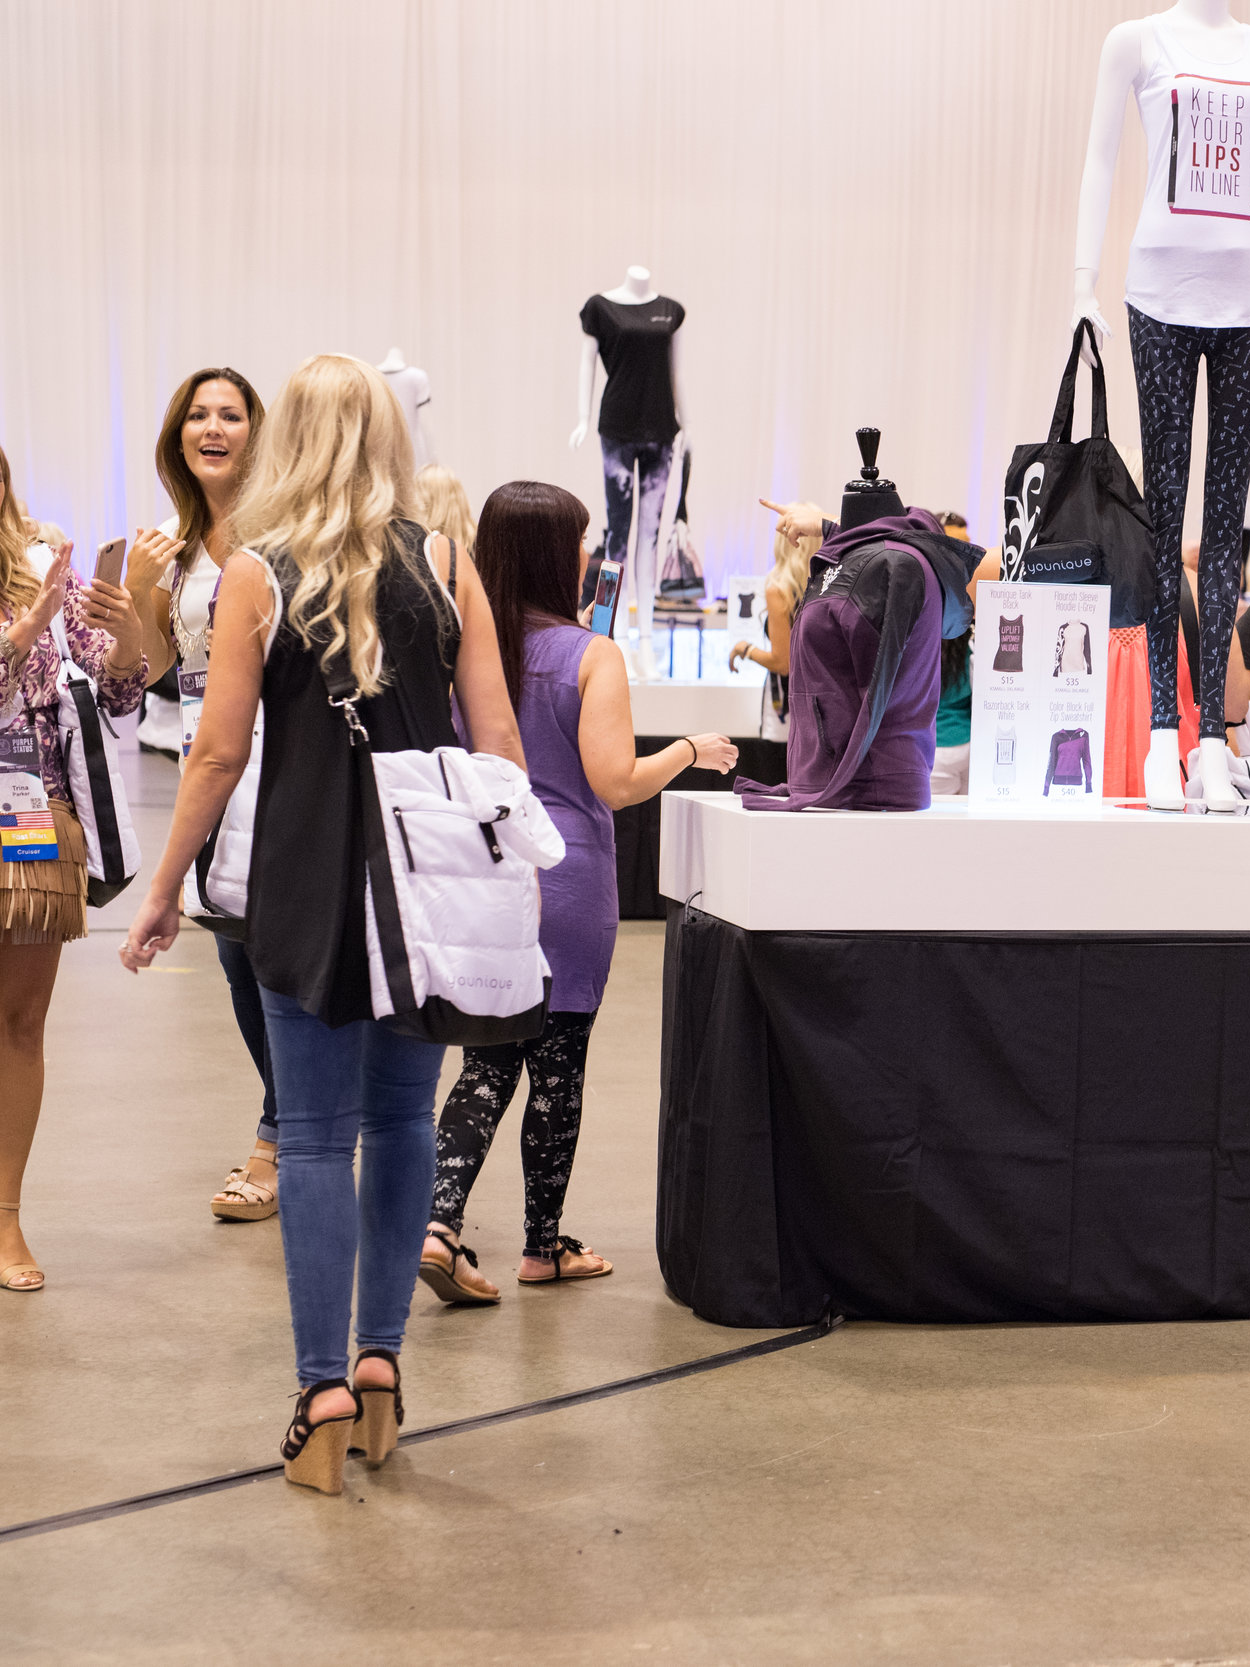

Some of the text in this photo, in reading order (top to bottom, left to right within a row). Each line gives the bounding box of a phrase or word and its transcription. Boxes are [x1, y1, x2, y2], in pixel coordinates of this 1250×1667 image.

[1191, 87, 1245, 118] KEEP
[1190, 115, 1243, 145] YOUR
[1192, 142, 1241, 172] LIPS
[1190, 170, 1241, 197] IN LINE
[1027, 558, 1092, 575] younique
[990, 589, 1032, 601] Younique Tank
[1054, 591, 1098, 602] Flourish Sleeve
[1002, 599, 1019, 609] Black
[1055, 601, 1076, 611] Hoodie
[1001, 625, 1020, 635] UPLIFT
[1001, 676, 1014, 685] $15
[1065, 677, 1080, 687] $35
[983, 700, 1030, 711] Razorback Tank
[997, 711, 1016, 721] White
[13, 745, 33, 753] STATUS
[997, 787, 1010, 796] $15
[1061, 787, 1076, 796] $40
[447, 976, 513, 990] younique
